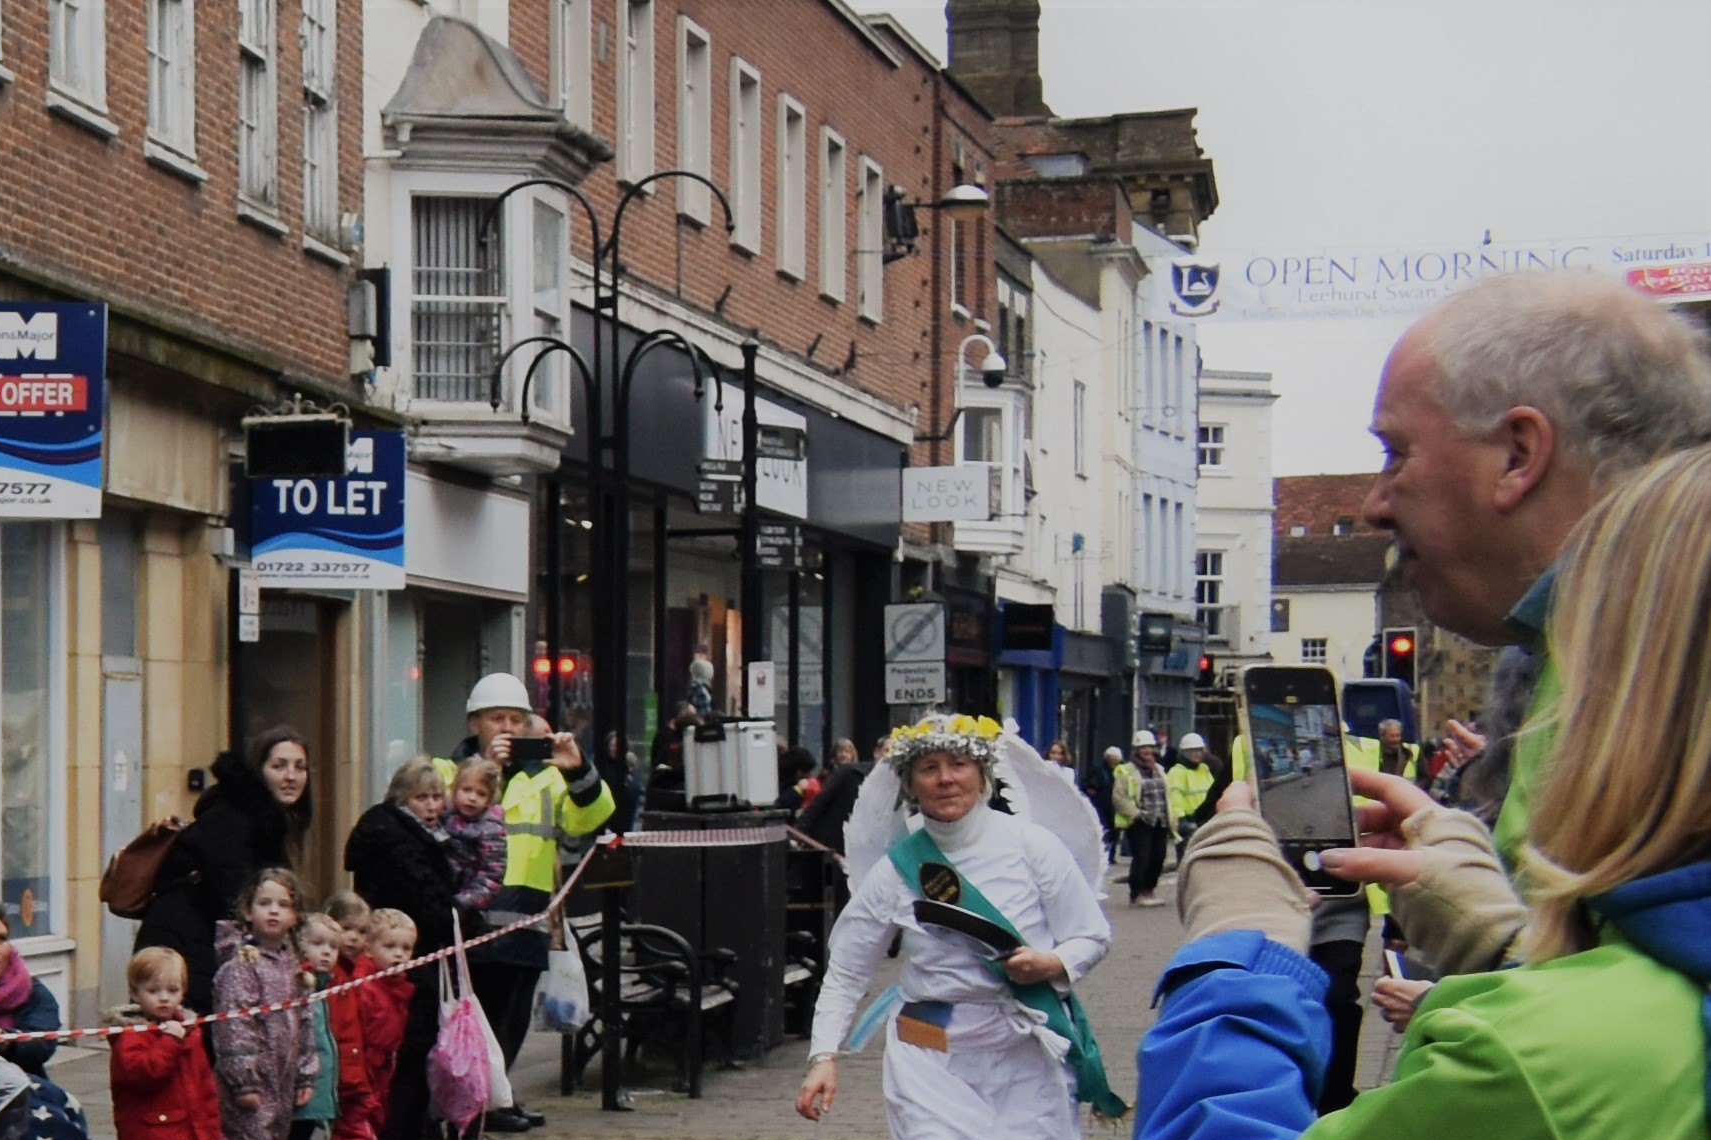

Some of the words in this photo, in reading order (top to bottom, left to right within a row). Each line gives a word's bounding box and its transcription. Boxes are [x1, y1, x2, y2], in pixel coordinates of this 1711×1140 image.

[1245, 255, 1358, 287] OPEN
[1611, 242, 1696, 264] Saturday
[1386, 285, 1437, 299] Swan
[1, 382, 74, 405] OFFER
[916, 480, 972, 493] NEW
[272, 479, 318, 515] TO
[327, 480, 388, 515] LET
[912, 495, 978, 510] LOOK
[257, 562, 305, 572] 01722
[311, 562, 371, 572] 337577
[894, 688, 936, 700] ENDS
